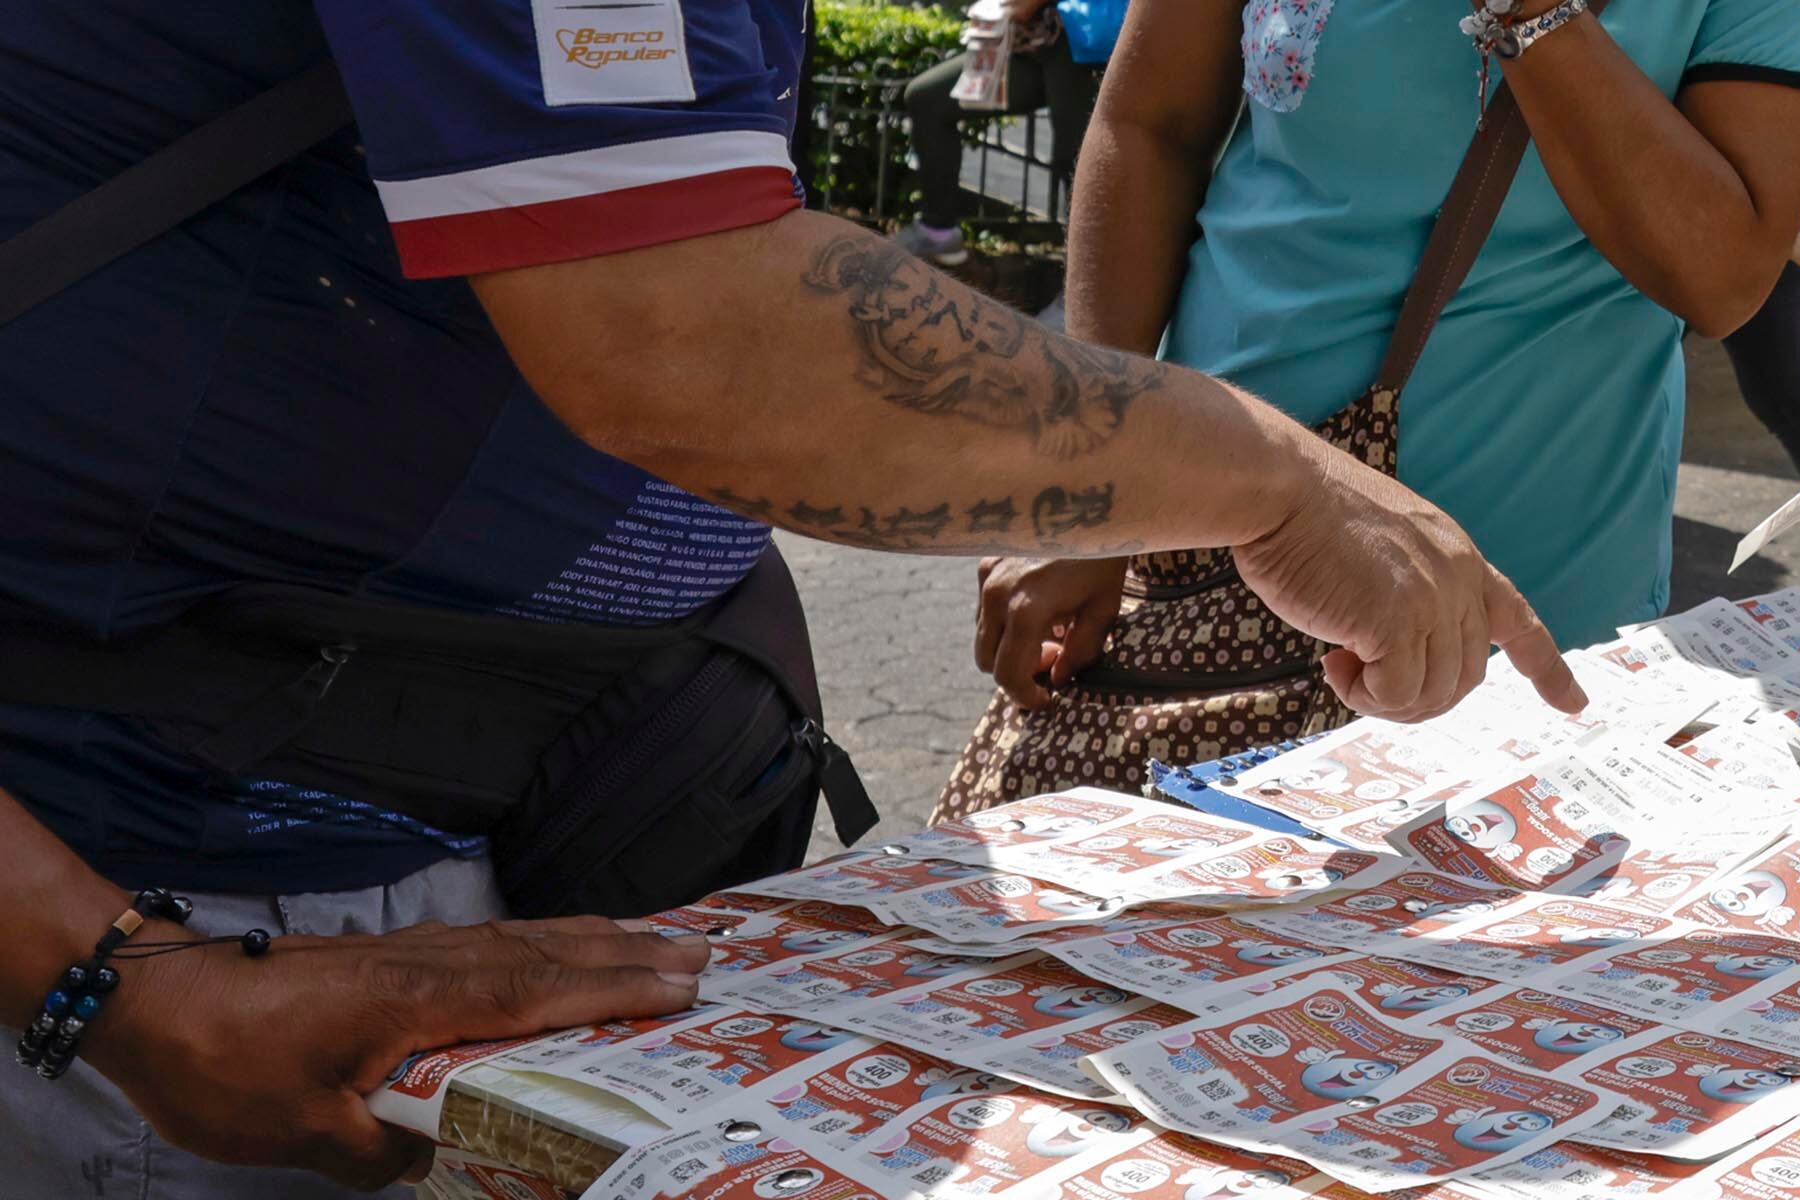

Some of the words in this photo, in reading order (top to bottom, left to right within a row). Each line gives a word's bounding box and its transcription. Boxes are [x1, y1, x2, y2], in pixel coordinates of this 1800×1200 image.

[573, 28, 664, 45] Banco
[566, 46, 676, 66] Popular
[584, 575, 623, 589] STEWART
[1203, 1029, 1254, 1066] BIENESTAR
[1246, 1032, 1274, 1050] 400
[863, 1064, 892, 1080] 400
[1113, 1061, 1132, 1077] E2
[1767, 1164, 1800, 1180] 400
